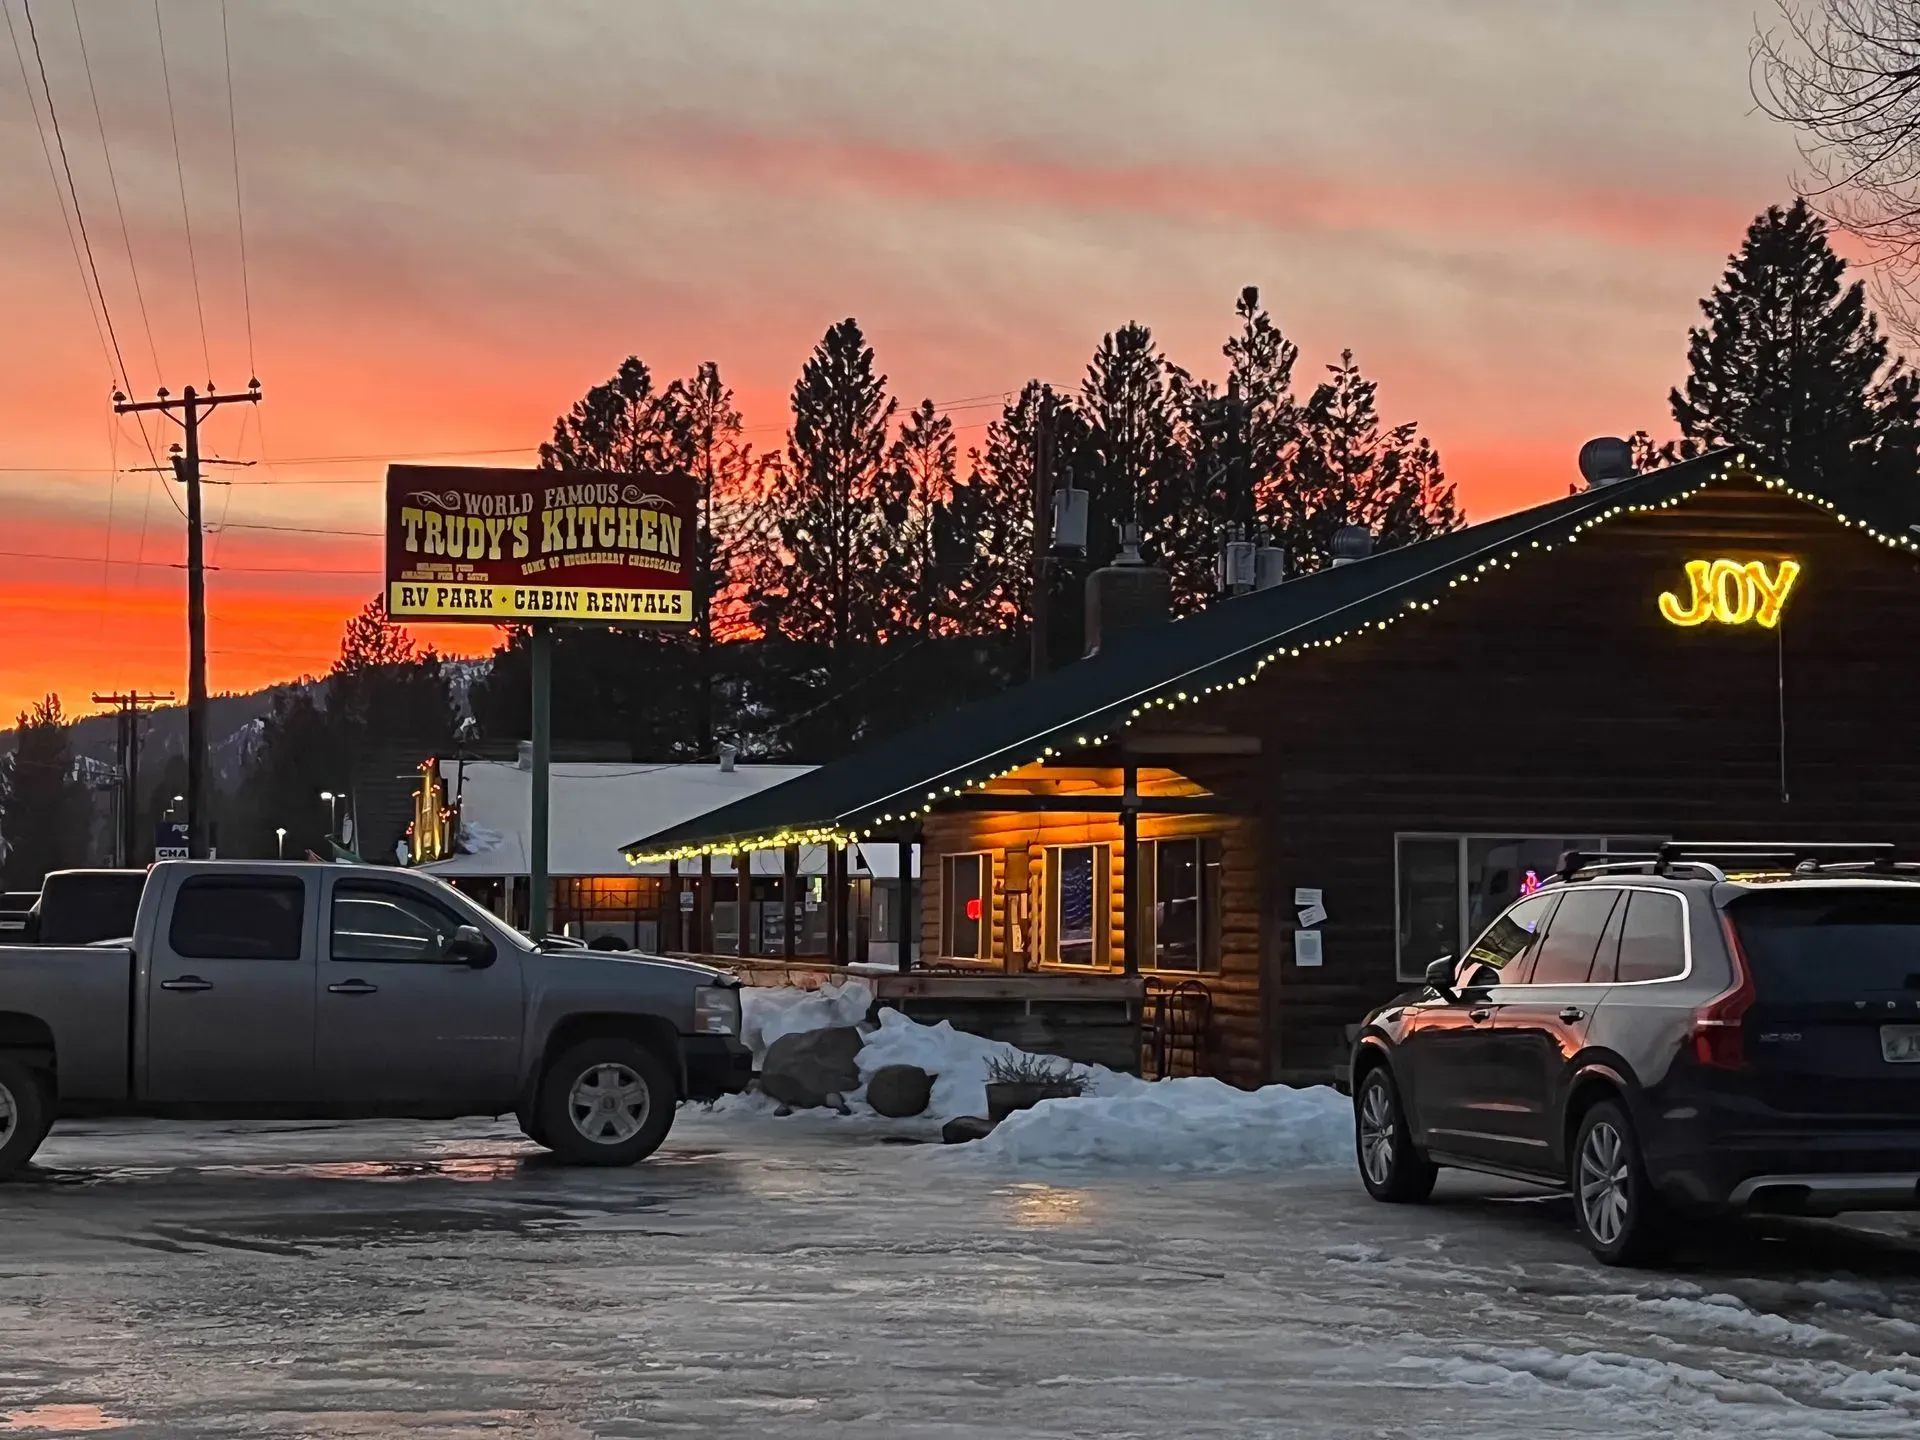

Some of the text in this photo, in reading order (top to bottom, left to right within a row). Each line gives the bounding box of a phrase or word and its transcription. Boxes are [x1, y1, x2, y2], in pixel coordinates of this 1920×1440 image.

[463, 483, 619, 517] WORLD FAMOUS
[401, 506, 682, 560] TRUDY'S KITCHEN
[563, 552, 625, 567] HUCKLEBERRY
[628, 555, 682, 574] CHEESECAKE
[401, 587, 682, 614] RV PARK CABIN RENTALS
[1658, 559, 1800, 628] JOY
